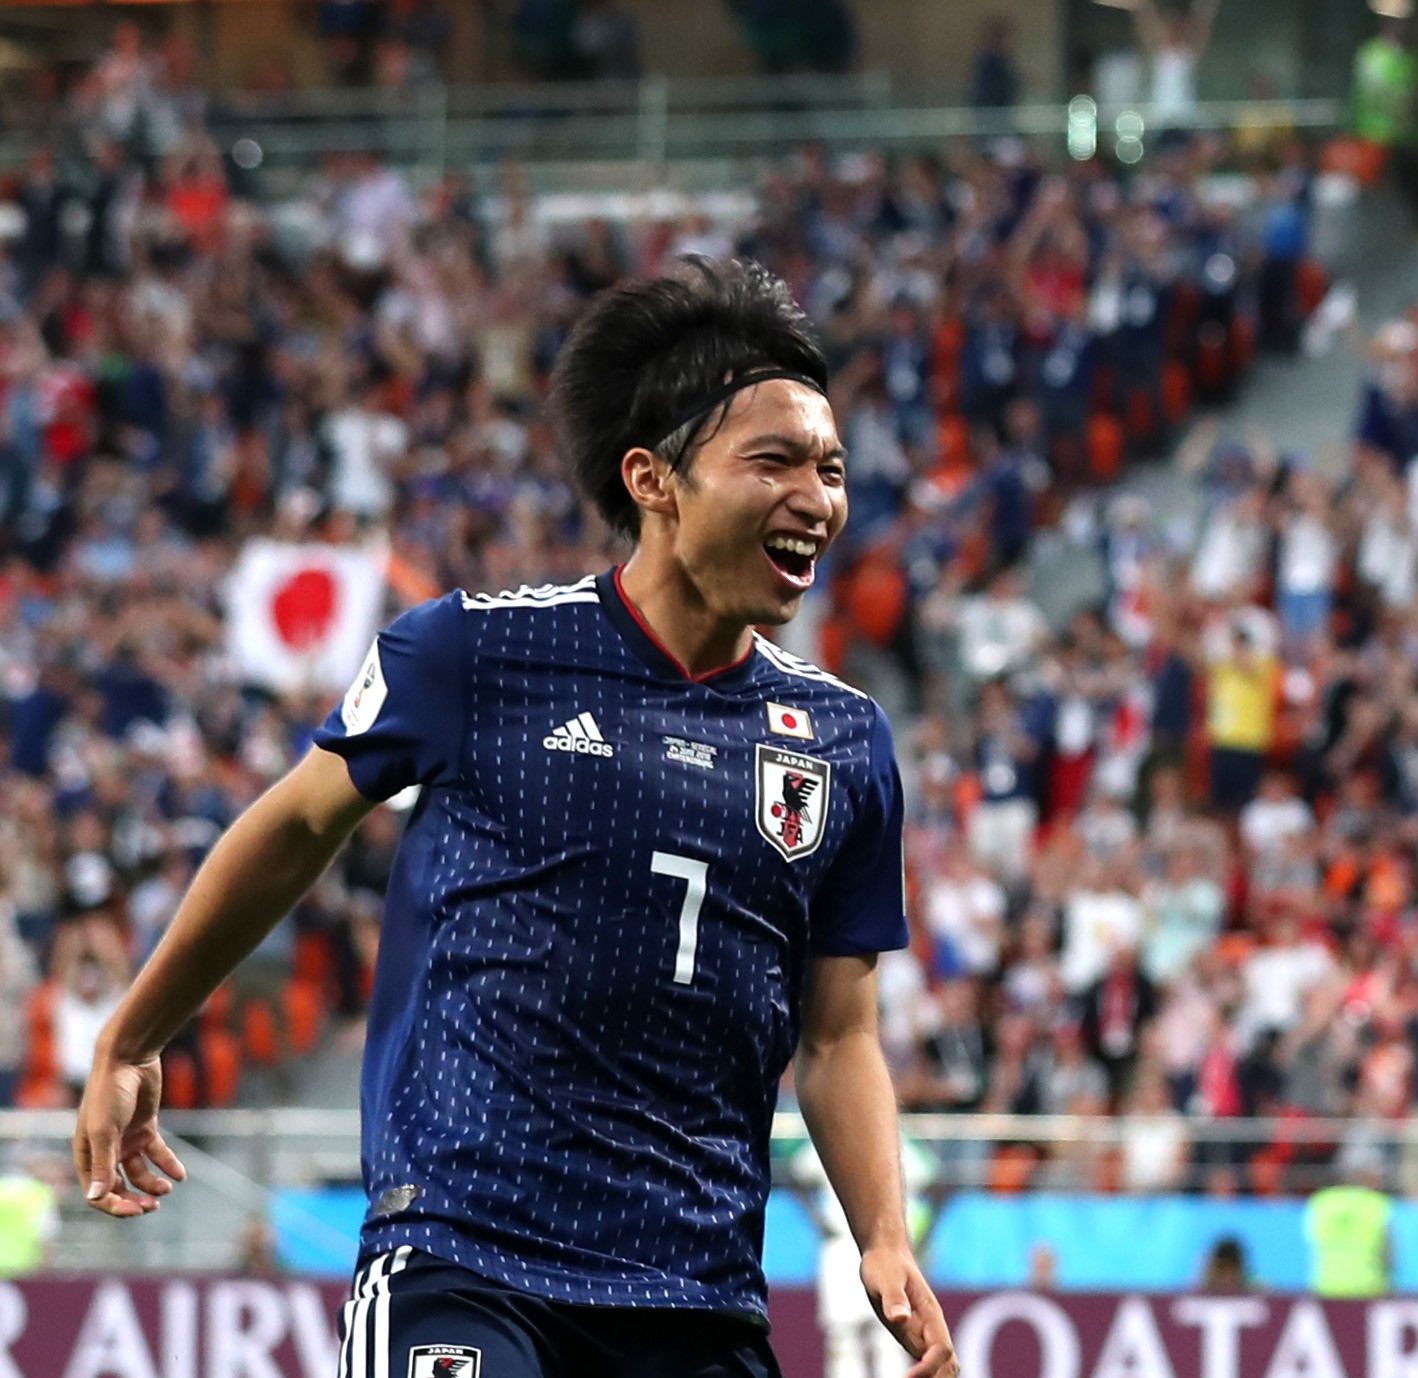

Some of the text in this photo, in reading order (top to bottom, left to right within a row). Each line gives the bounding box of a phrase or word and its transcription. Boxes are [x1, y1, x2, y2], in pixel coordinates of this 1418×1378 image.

[543, 735, 614, 758] adidas
[776, 753, 814, 771] JAPAN
[651, 850, 709, 985] 7
